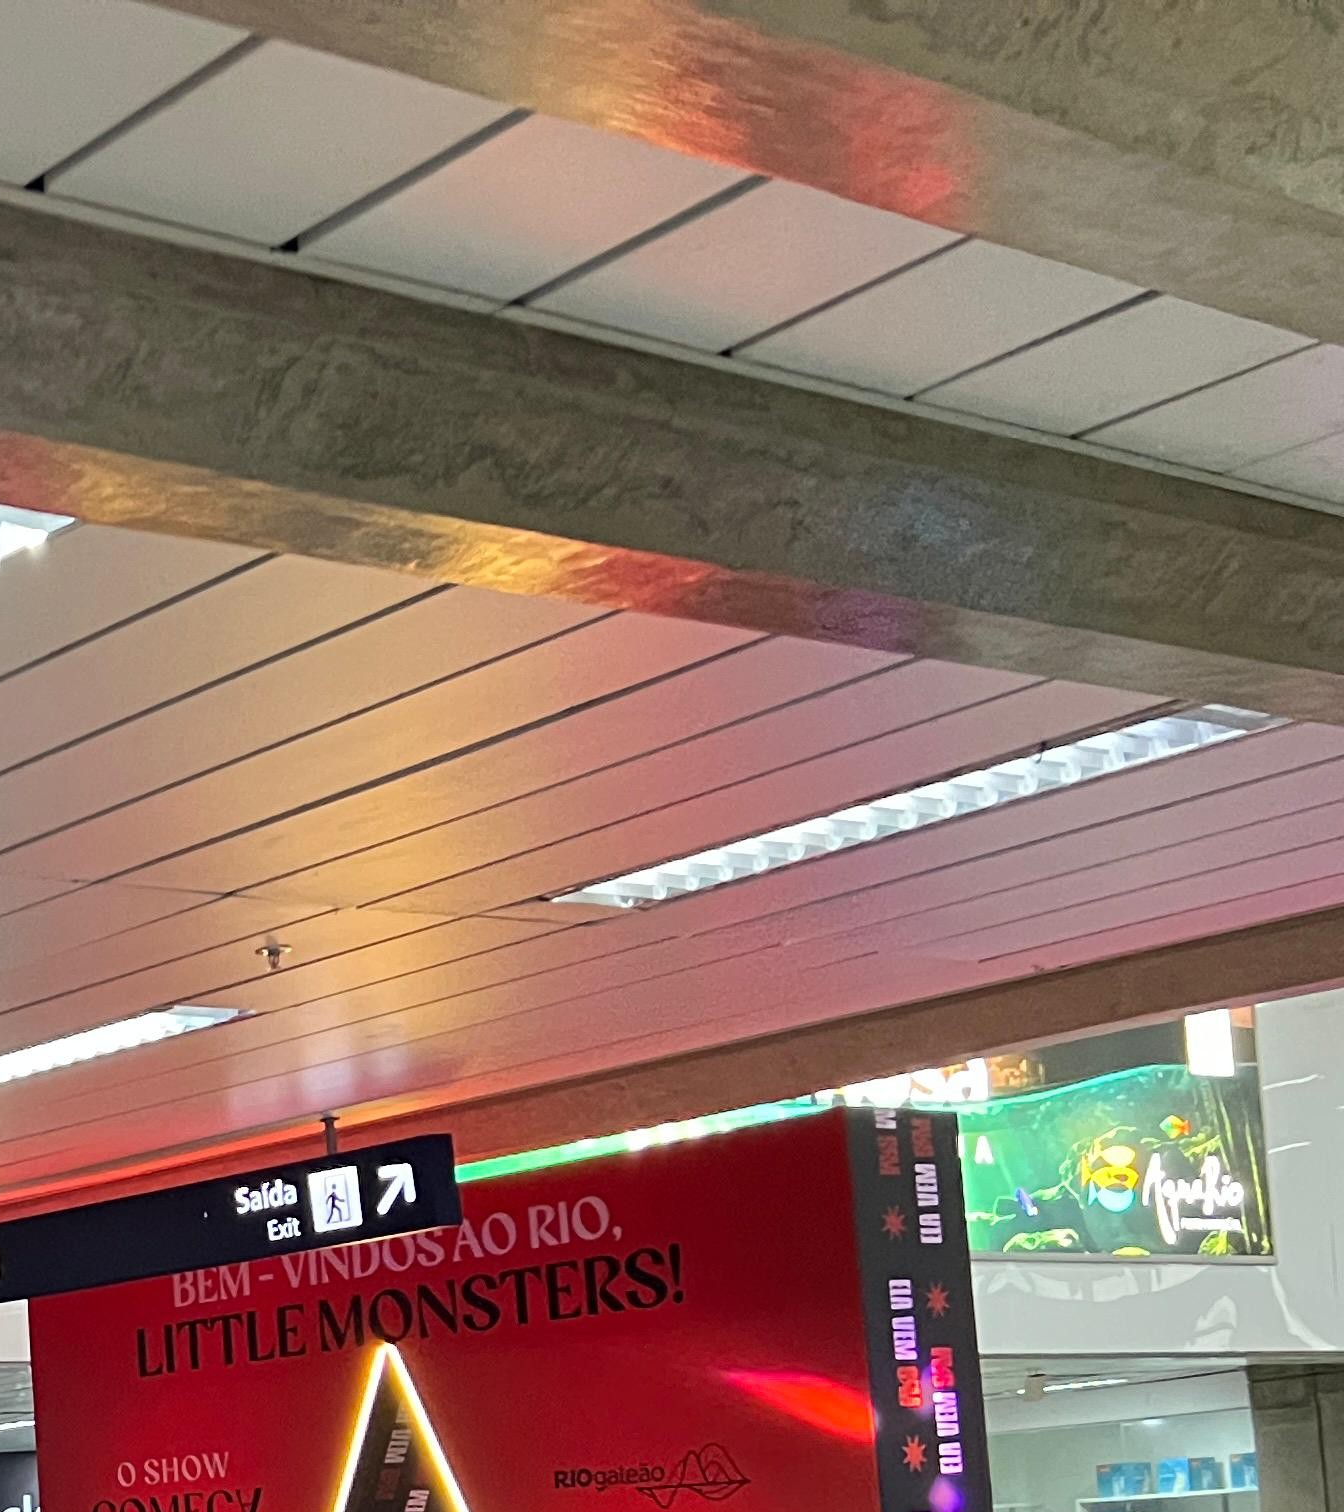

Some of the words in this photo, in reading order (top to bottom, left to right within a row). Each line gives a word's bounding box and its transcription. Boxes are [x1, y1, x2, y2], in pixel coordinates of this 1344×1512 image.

[235, 1178, 298, 1214] Saída
[267, 1217, 301, 1241] Exit
[172, 1262, 250, 1307] BEM
[452, 1212, 517, 1262] AO
[527, 1196, 622, 1249] RIO,
[136, 1303, 306, 1377] LITTLE
[318, 1242, 684, 1353] MONSTERS!
[117, 1461, 137, 1487] O
[143, 1451, 229, 1485] SHOW
